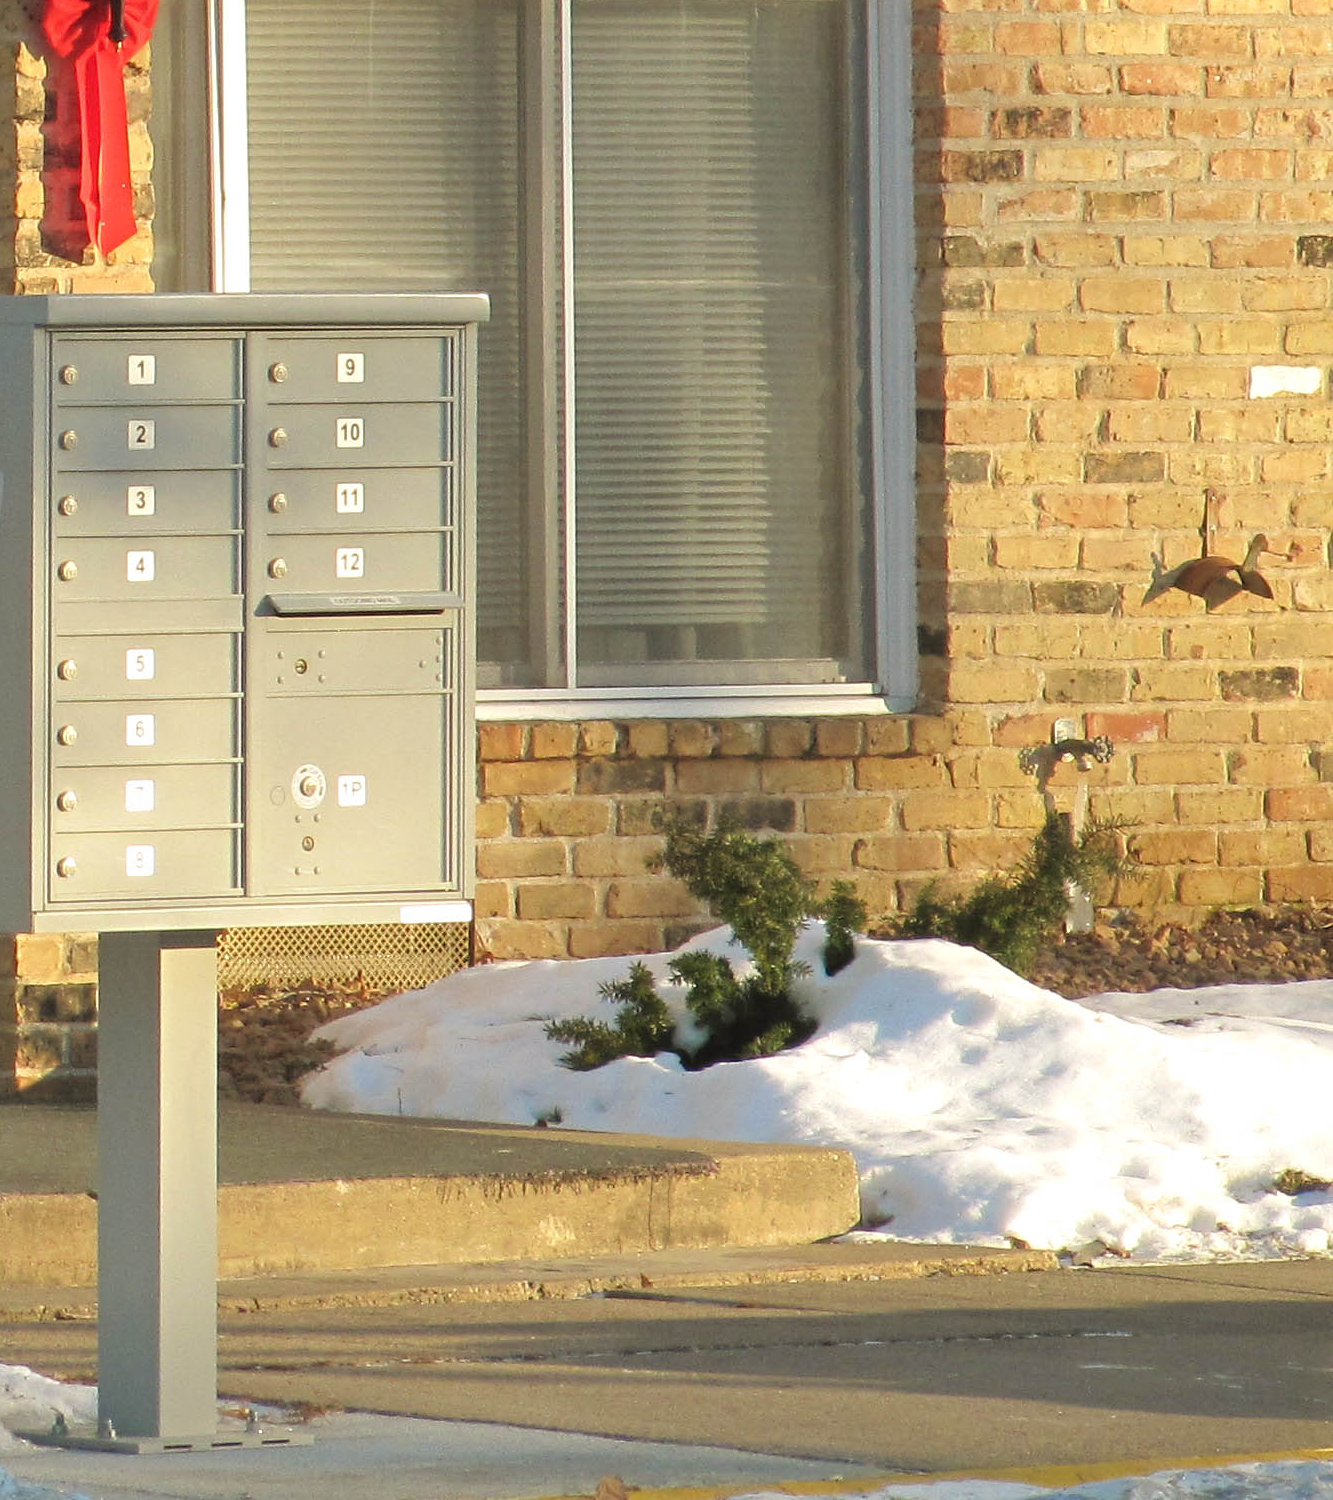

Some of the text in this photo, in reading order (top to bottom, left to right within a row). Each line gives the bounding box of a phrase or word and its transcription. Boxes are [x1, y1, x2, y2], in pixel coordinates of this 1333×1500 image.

[137, 360, 145, 379] 1
[345, 358, 356, 377] 9
[136, 424, 146, 444] 2
[340, 423, 360, 441] 10
[136, 490, 146, 510] 3
[340, 488, 358, 506] 11
[135, 556, 146, 573] 4
[340, 552, 360, 571] 12
[135, 654, 145, 672] 5
[135, 720, 145, 738] 6
[341, 780, 363, 797] 1P
